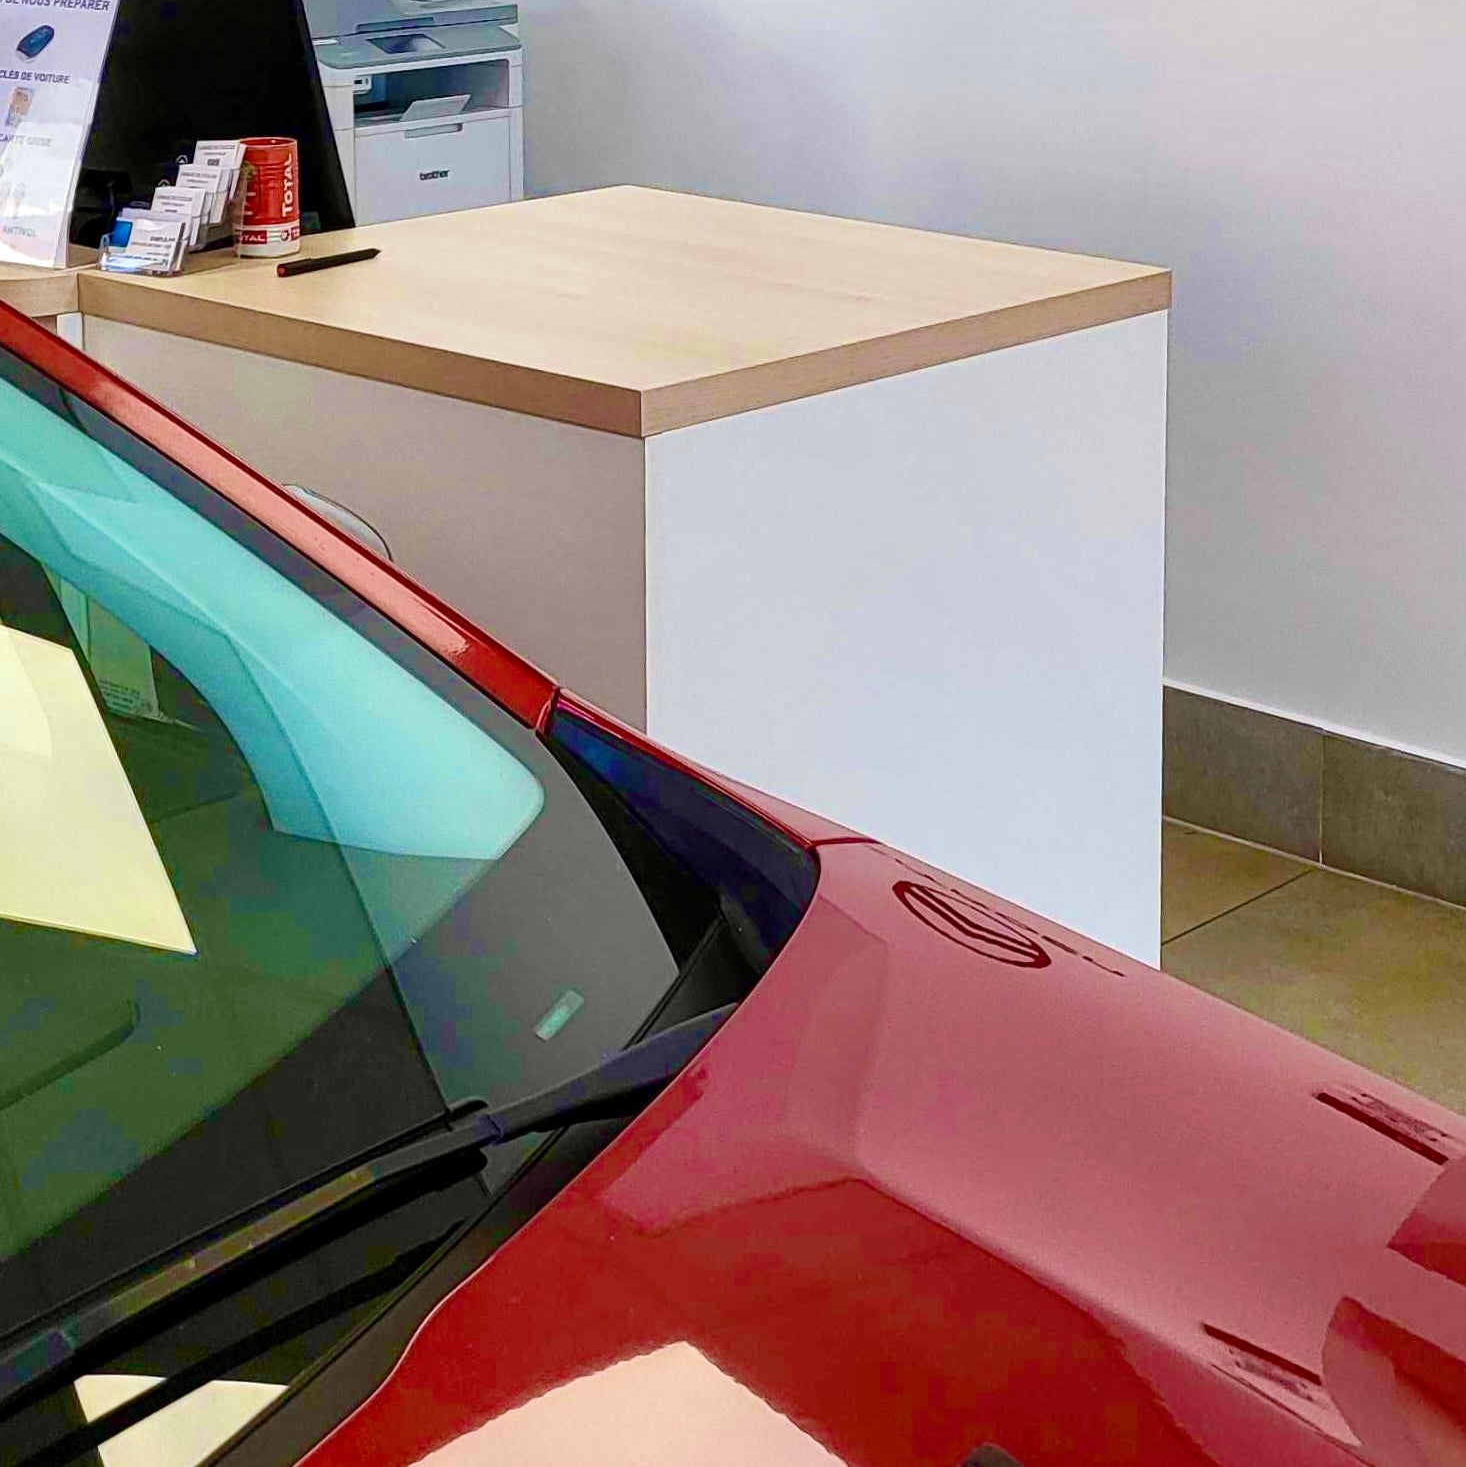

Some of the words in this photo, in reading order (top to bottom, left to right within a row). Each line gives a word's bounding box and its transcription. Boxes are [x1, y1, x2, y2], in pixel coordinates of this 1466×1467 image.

[21, 71, 32, 81] DE
[34, 72, 71, 84] VOITURE
[419, 170, 450, 180] brother
[282, 153, 294, 217] TOTAL
